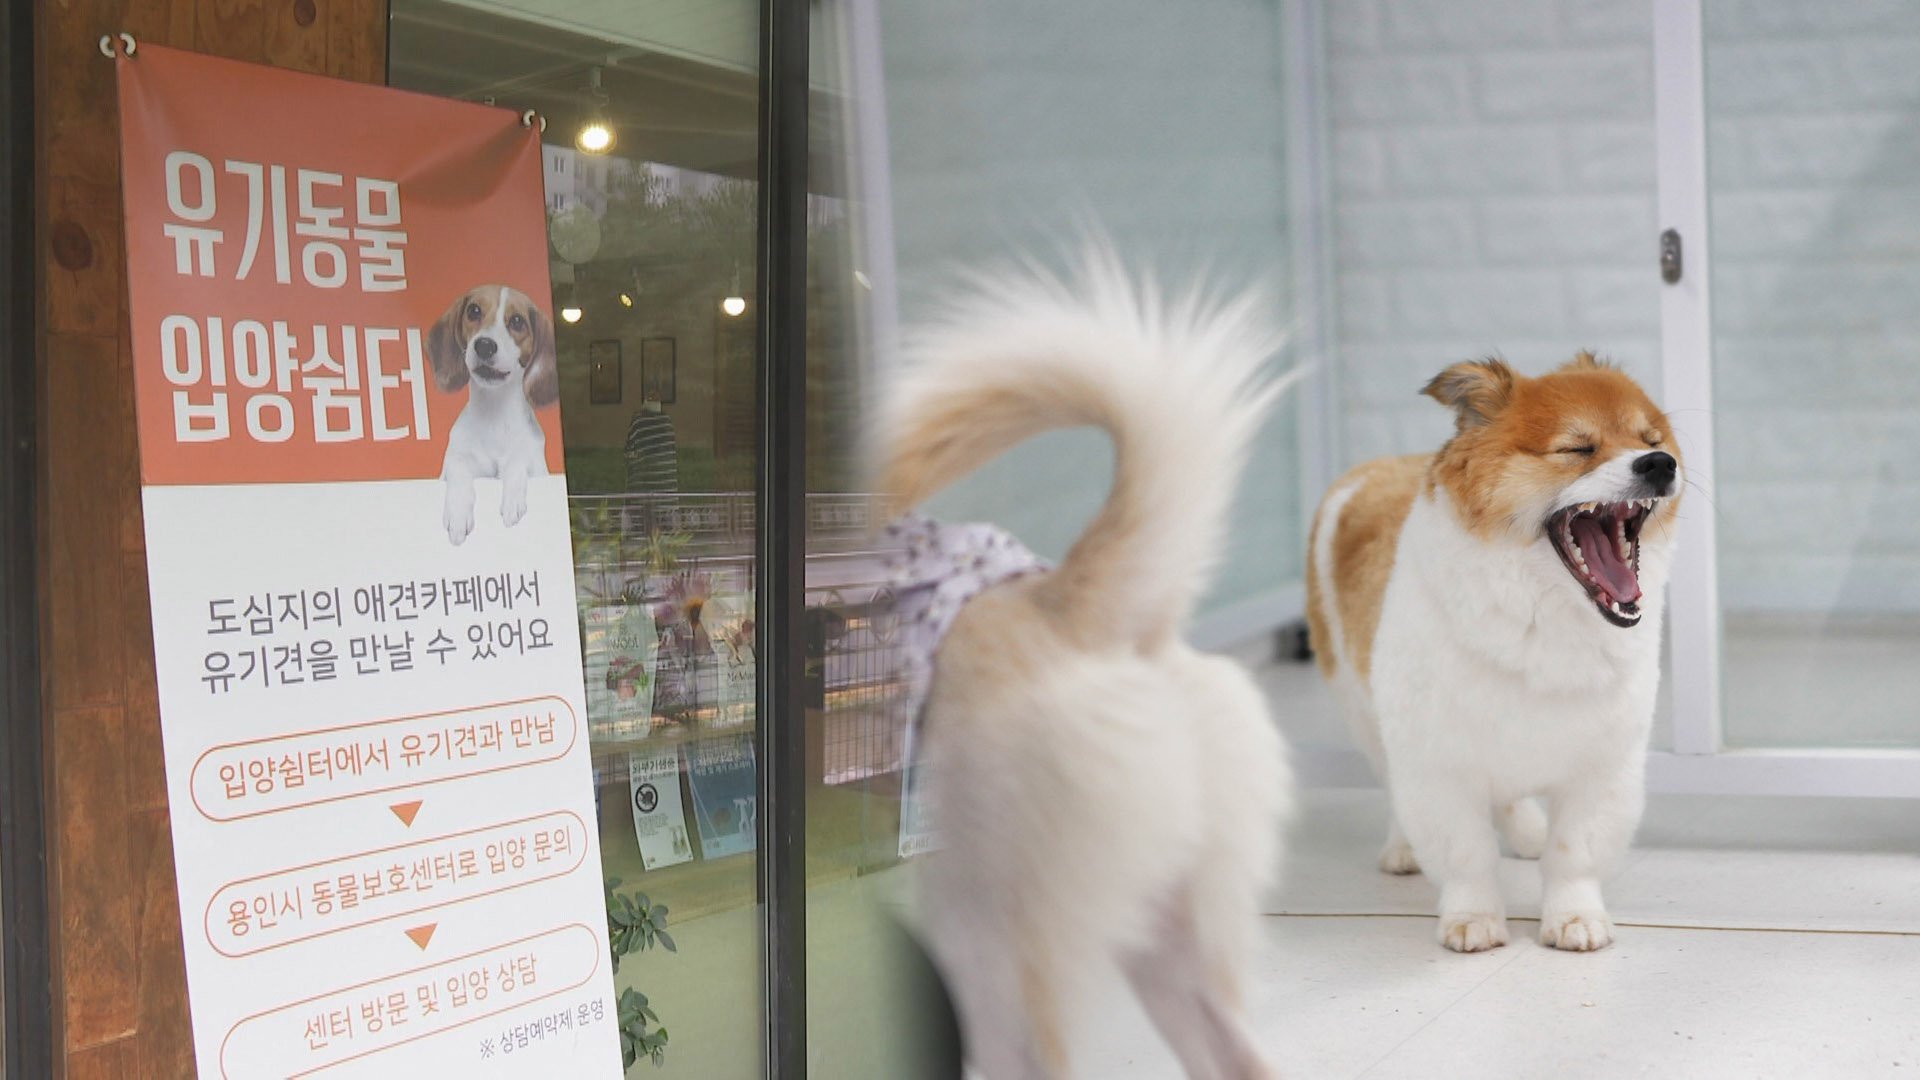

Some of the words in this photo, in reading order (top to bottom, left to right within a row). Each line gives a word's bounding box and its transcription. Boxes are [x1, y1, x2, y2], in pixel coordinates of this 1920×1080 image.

[163, 151, 408, 293] 유기동물
[160, 314, 431, 444] 입양쉼터
[207, 586, 343, 636] 도심지의
[353, 570, 541, 623] 애견카페에서
[201, 638, 338, 694] 유기견을
[349, 629, 415, 675] 만날
[426, 627, 457, 666] 수
[467, 617, 554, 661] 있어요
[219, 739, 391, 800] 입양쉼터에서
[399, 728, 503, 767] 유기견과
[510, 712, 556, 748] 만남
[227, 885, 303, 937] 용인시
[311, 848, 480, 916] 동물보호센터로
[486, 836, 526, 874] 입양
[533, 825, 573, 865] 문의
[303, 1003, 353, 1051] 센터
[361, 990, 409, 1034] 방문
[417, 984, 440, 1015] 및
[446, 965, 490, 1007] 입양
[497, 952, 538, 992] 상담
[500, 1008, 573, 1054] 상담예약제
[577, 997, 604, 1026] 운영
